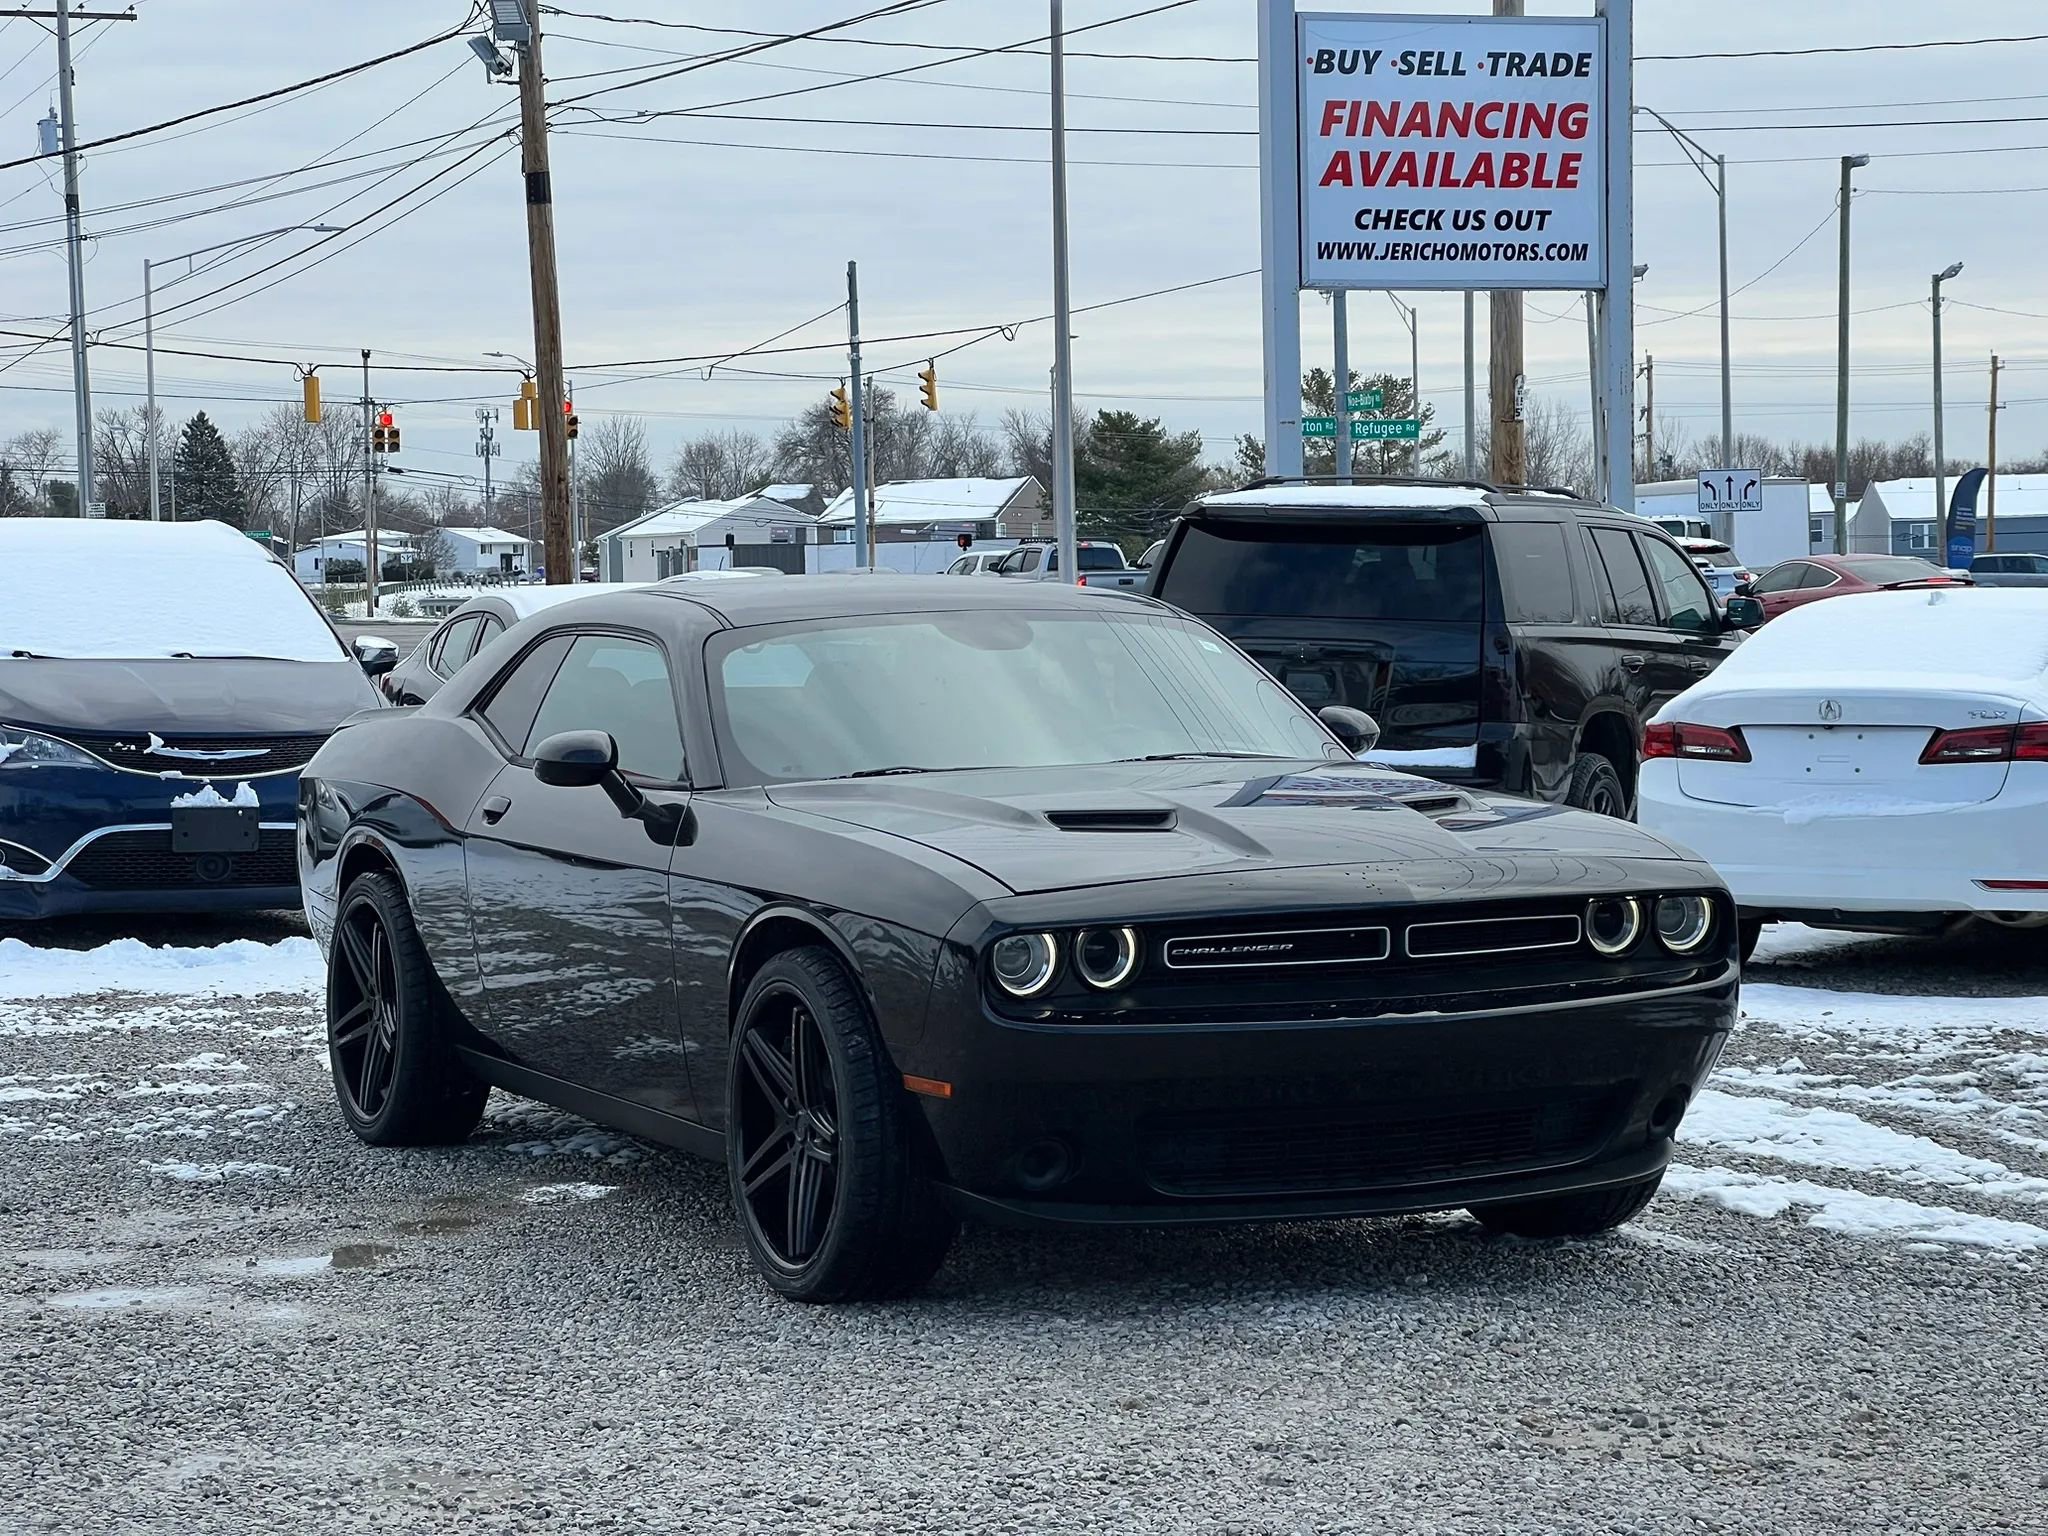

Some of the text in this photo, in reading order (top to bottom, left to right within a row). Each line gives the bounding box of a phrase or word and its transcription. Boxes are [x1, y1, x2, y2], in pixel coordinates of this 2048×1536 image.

[1319, 100, 1589, 139] FINANCING
[1318, 150, 1582, 189] AVAILABLE
[1354, 208, 1552, 232] CHECK US OUT
[1317, 241, 1588, 262] WWW.JERICHOMOTORS.COM
[1325, 422, 1334, 430] Rd
[1355, 422, 1415, 437] Refugee Rd
[1700, 502, 1719, 510] ONLY
[1721, 501, 1739, 509] ONLY
[1968, 710, 2007, 719] TLX
[1171, 944, 1293, 955] CHALLENGER
